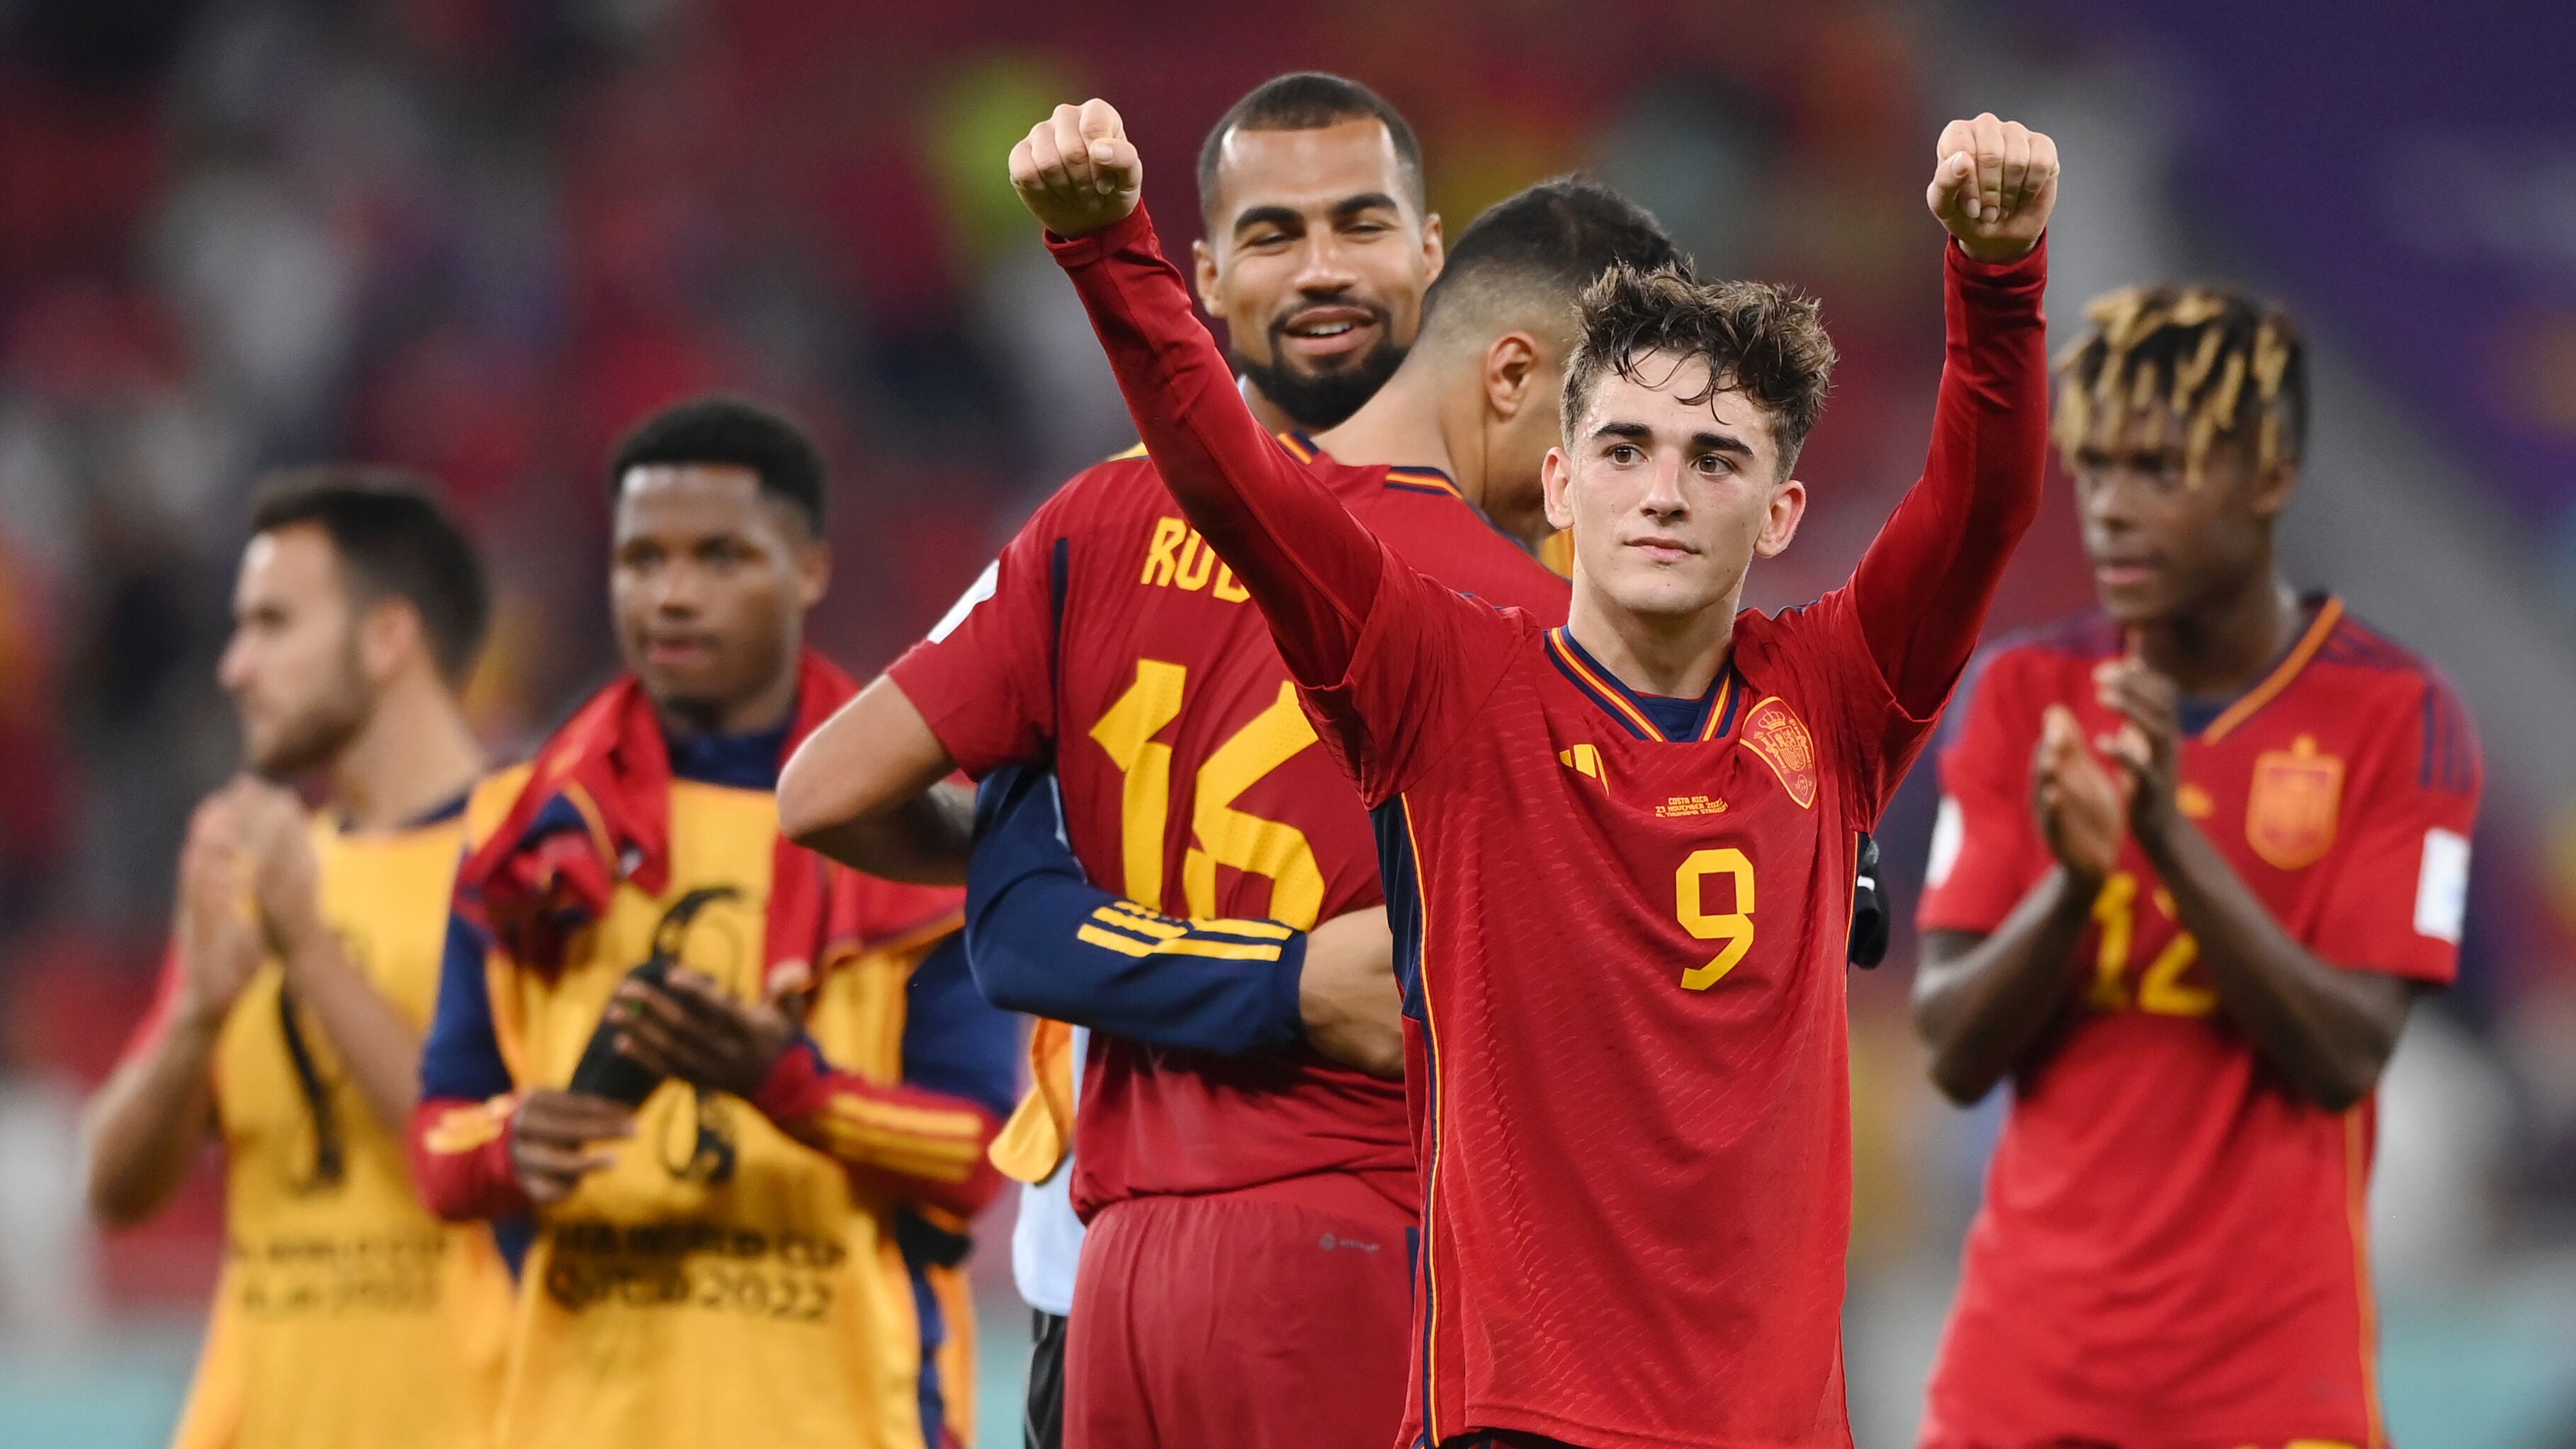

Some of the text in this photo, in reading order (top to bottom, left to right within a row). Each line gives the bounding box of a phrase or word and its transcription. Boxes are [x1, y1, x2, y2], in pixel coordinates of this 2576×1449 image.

[1089, 658, 1325, 932] 16
[1667, 803, 1705, 812] NOVEMBER
[1675, 848, 1755, 991] 9
[2091, 872, 2219, 1015] 12
